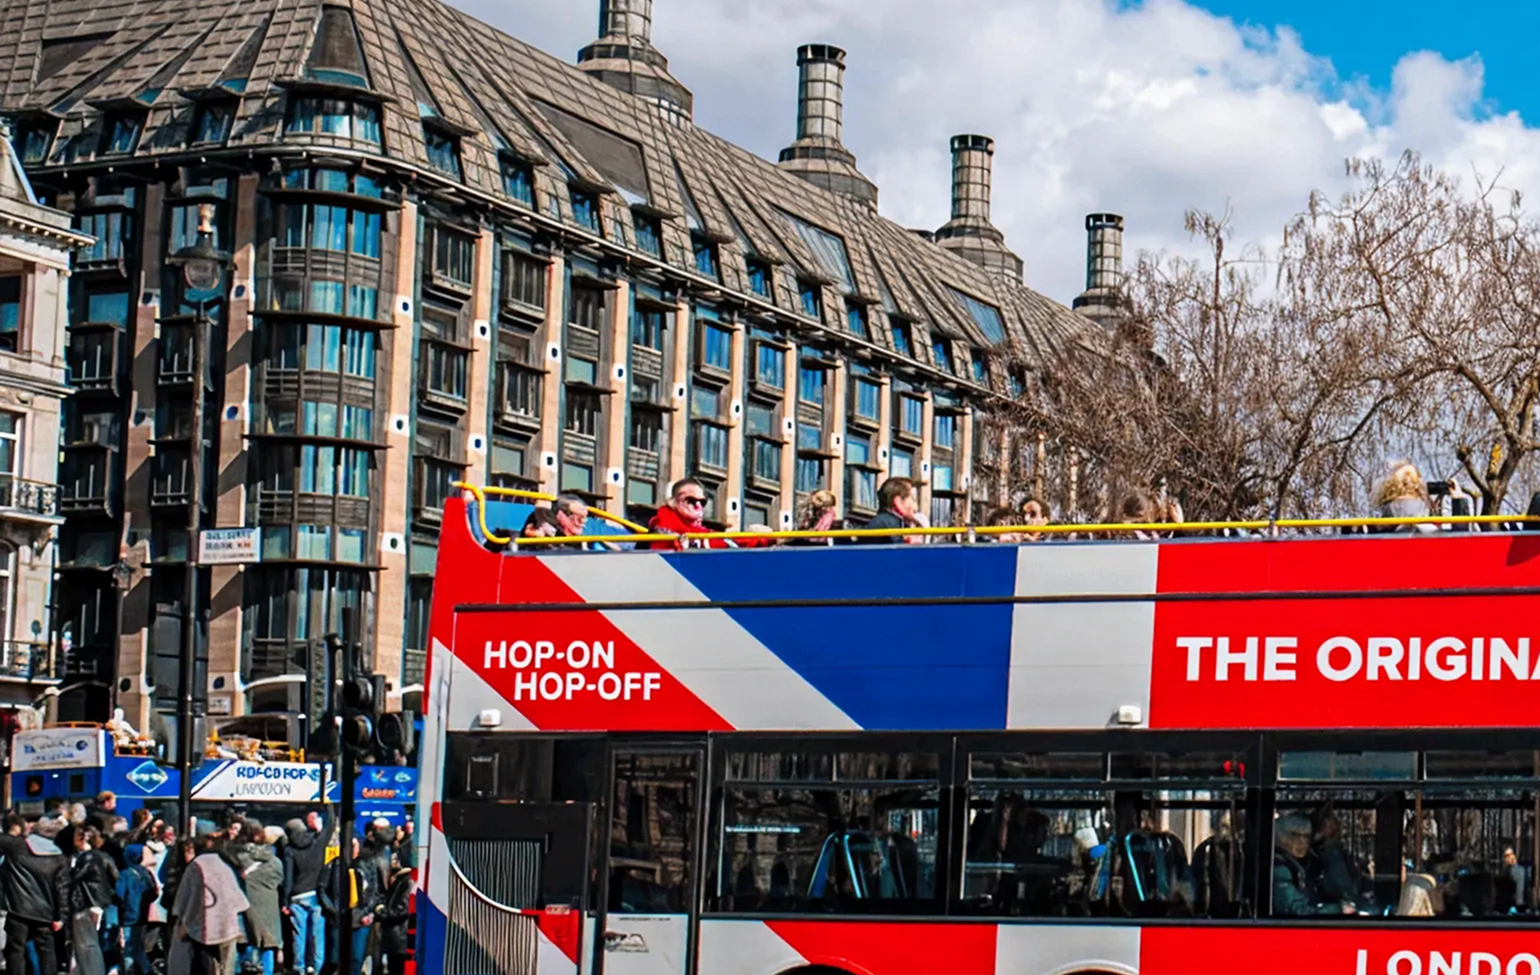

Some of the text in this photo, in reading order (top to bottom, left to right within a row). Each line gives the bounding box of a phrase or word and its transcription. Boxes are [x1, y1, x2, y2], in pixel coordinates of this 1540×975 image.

[483, 640, 615, 669] HOP-ON
[1176, 636, 1298, 681] THE
[514, 671, 661, 701] HOP-OFF
